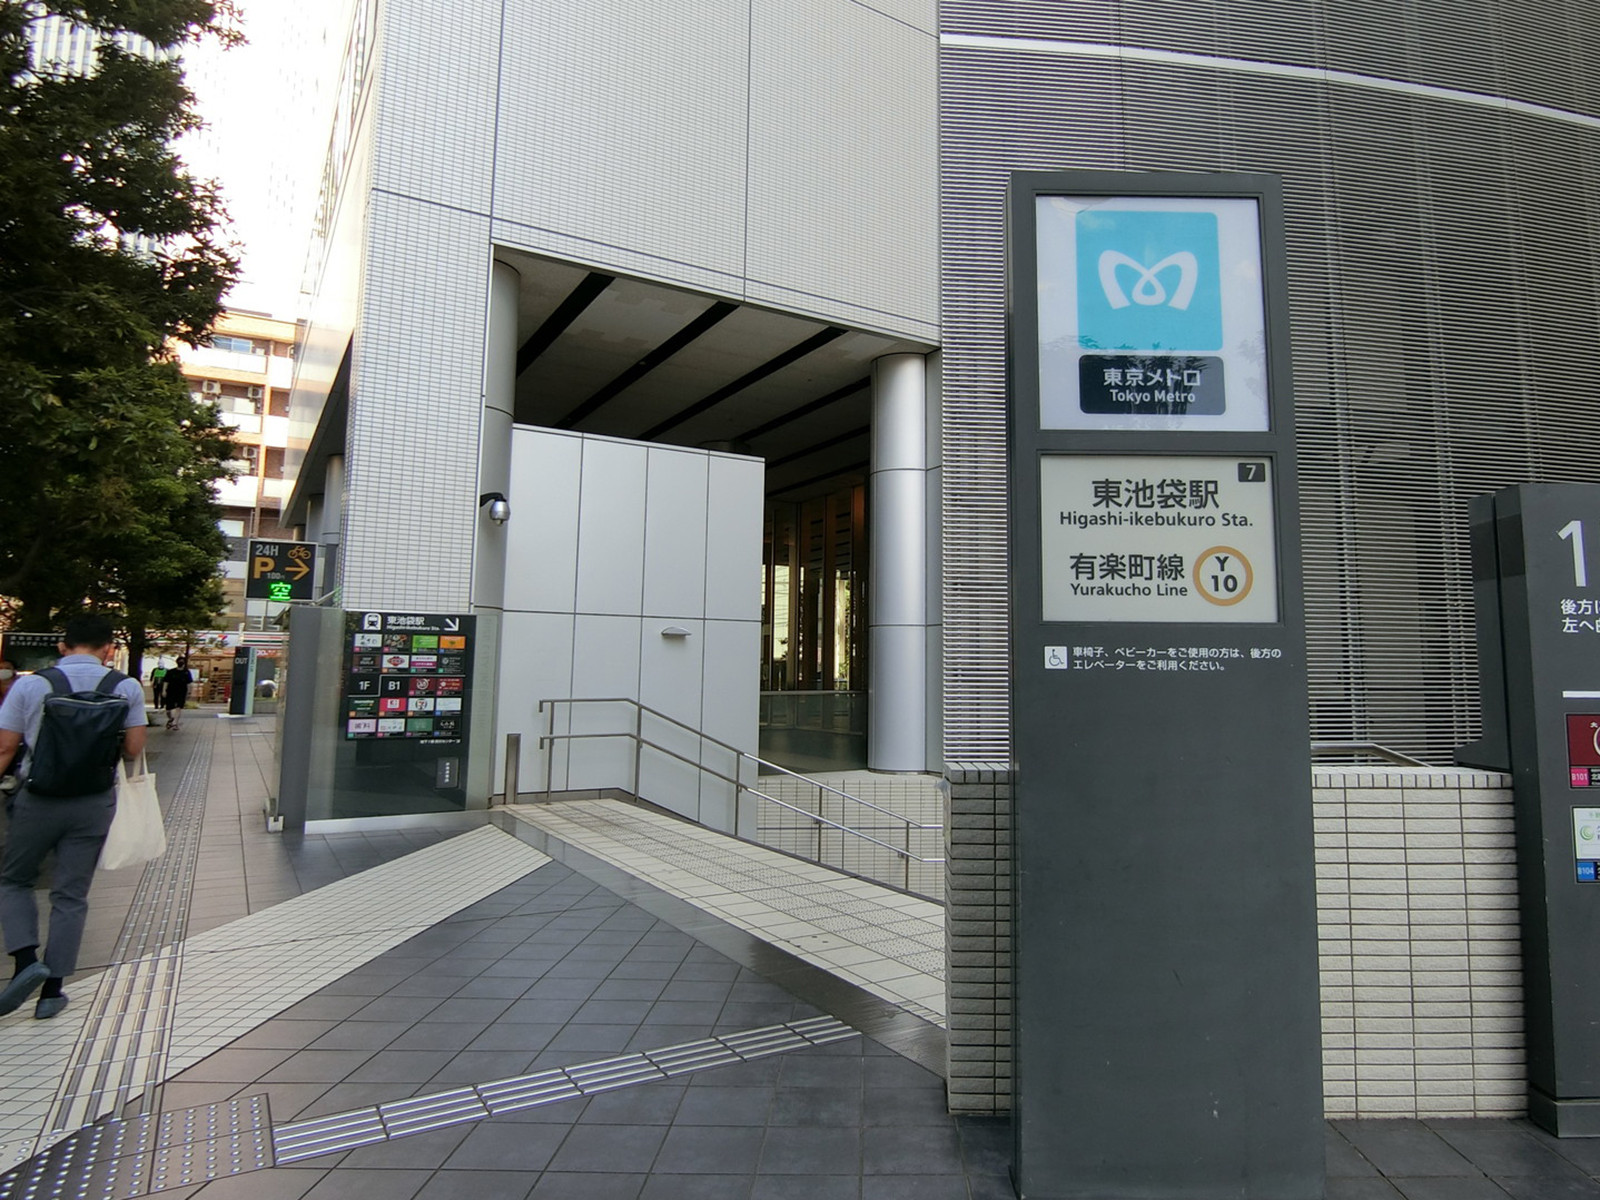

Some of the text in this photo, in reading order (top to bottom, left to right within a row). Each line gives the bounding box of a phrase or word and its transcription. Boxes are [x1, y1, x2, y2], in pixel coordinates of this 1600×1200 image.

[1103, 368, 1200, 386] 東京メトロ
[1109, 389, 1195, 404] Tokyo Metro
[1246, 465, 1256, 480] 7
[1092, 479, 1219, 509] 東池袋駅
[1060, 511, 1253, 529] Higashi-ikebukuro Sta.
[255, 544, 279, 556] 24H
[253, 556, 275, 579] P
[1070, 553, 1185, 581] 有楽町線
[1214, 556, 1230, 572] Y
[270, 582, 292, 600] 空
[1070, 583, 1188, 597] Yurakucho Line
[1211, 575, 1238, 593] 10
[235, 657, 249, 665] OUT
[1073, 659, 1225, 671] エレベーターをご利用ください。
[358, 681, 371, 691] 1F
[388, 681, 400, 691] B1
